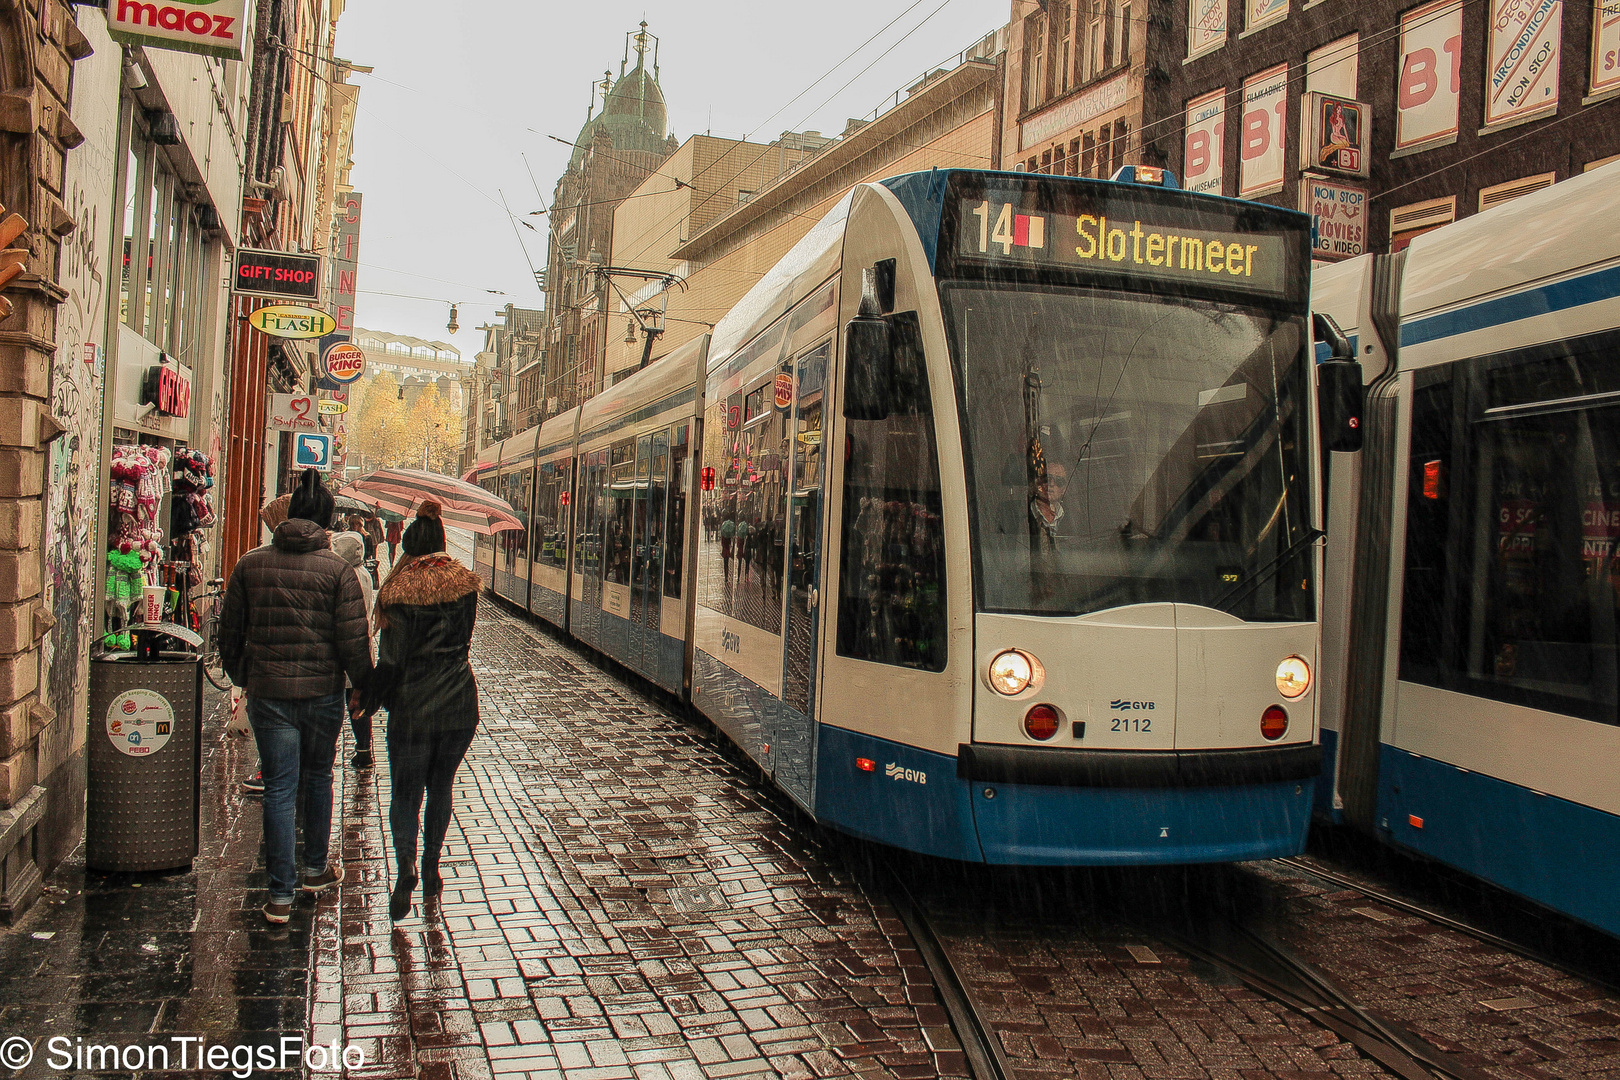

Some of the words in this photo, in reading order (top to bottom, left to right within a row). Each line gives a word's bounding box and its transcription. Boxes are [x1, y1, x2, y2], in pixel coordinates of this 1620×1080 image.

[117, 0, 235, 39] maoz
[1203, 2, 1221, 28] NON
[1494, 0, 1521, 33] TOEG
[1203, 12, 1223, 40] STOP
[1399, 34, 1460, 110] B1
[1506, 76, 1530, 106] NON
[1528, 40, 1551, 75] STOP
[1195, 106, 1219, 122] CINEMA
[1242, 99, 1286, 160] B1
[1185, 122, 1223, 178] B1
[1341, 150, 1358, 169] B1
[1315, 187, 1335, 200] NON
[1340, 191, 1363, 205] STOP
[973, 201, 1013, 255] 14
[1075, 214, 1258, 276] Slotermeer
[1334, 240, 1361, 255] VIDEO
[240, 265, 272, 280] GIFT
[275, 268, 314, 283] SHOP
[261, 312, 324, 333] FLASH
[329, 352, 362, 361] BURGER
[329, 359, 362, 372] KING
[1132, 701, 1155, 710] GVB
[1111, 718, 1151, 732] 2112
[905, 770, 926, 784] GVB
